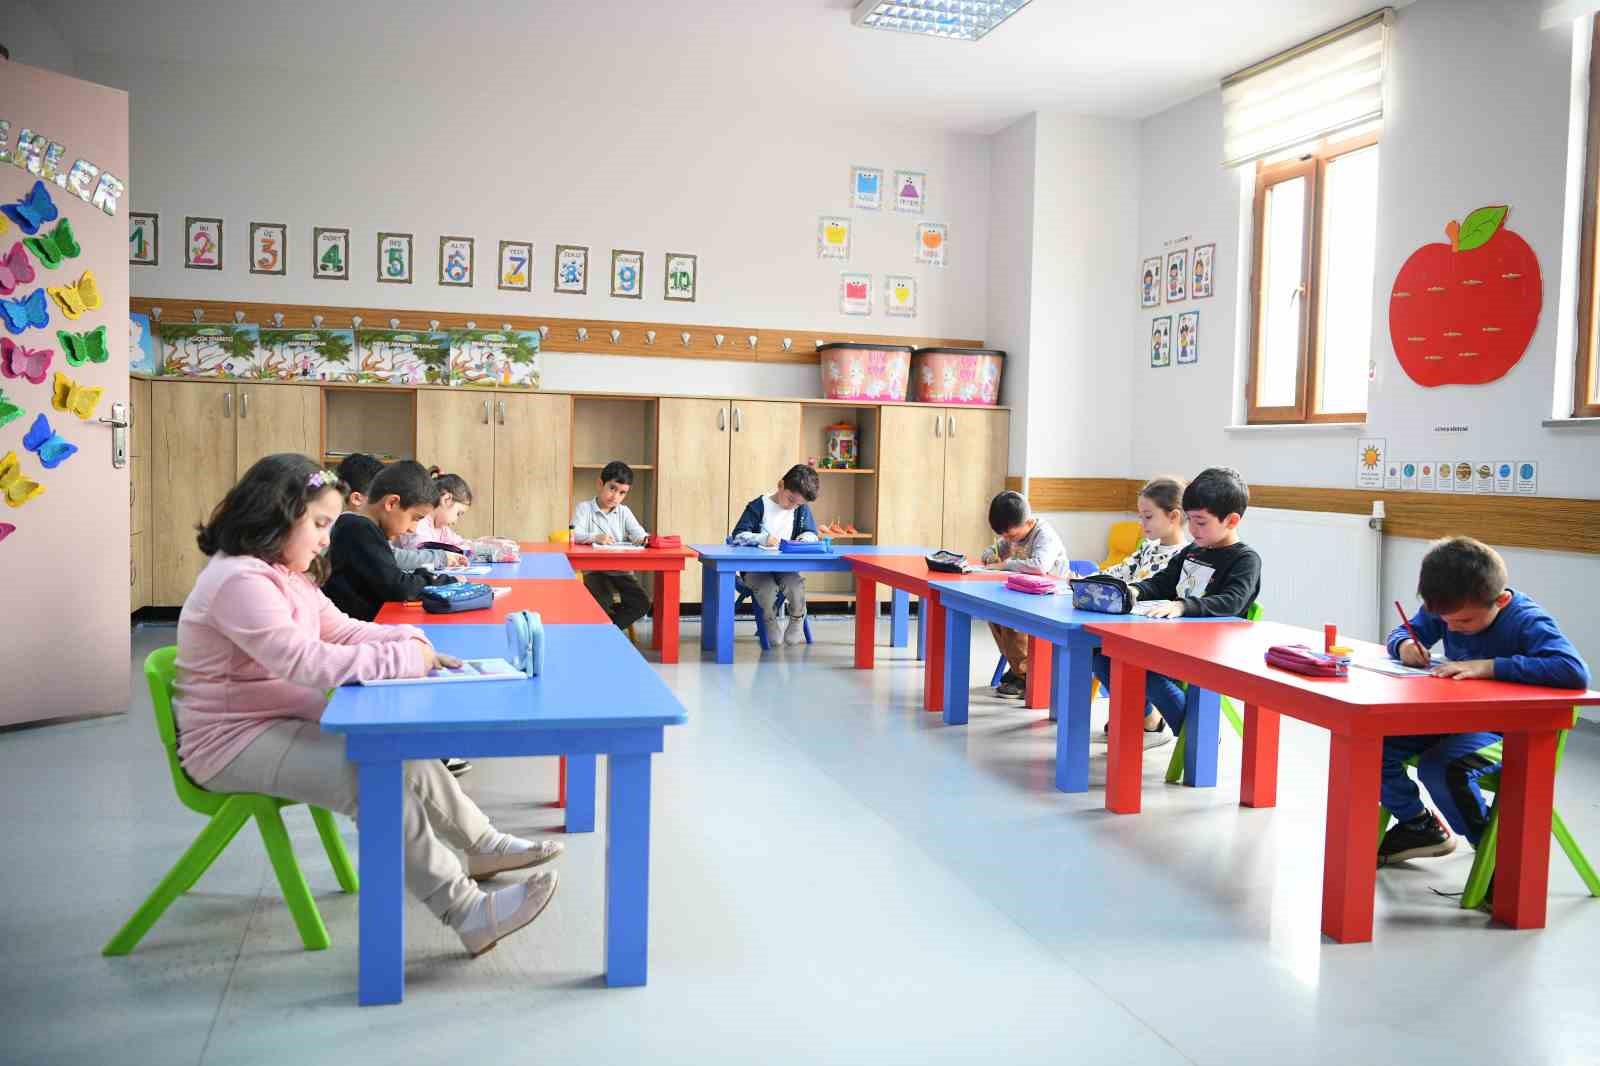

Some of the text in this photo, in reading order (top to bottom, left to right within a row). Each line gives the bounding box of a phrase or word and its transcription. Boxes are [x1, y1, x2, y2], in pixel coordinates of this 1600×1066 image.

[130, 226, 145, 258] 1
[193, 231, 215, 264] 2
[257, 238, 278, 269] 3
[321, 244, 342, 270] 4
[384, 247, 404, 278] 5
[446, 253, 467, 281] 6
[509, 256, 527, 276] 7
[564, 264, 579, 284] 8
[618, 265, 636, 292] 9
[669, 271, 692, 291] 10
